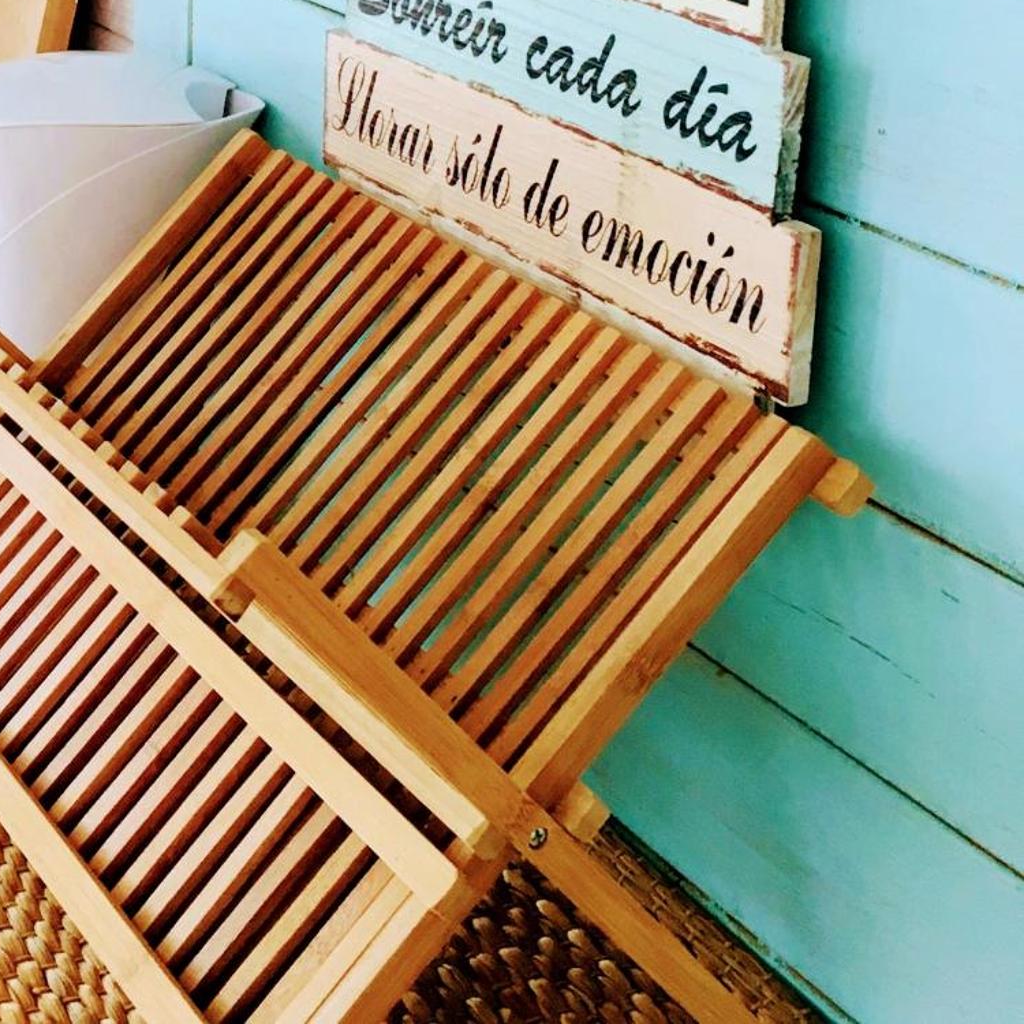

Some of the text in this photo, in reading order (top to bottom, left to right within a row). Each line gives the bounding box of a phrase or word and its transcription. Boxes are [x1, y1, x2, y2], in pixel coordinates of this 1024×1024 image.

[331, 57, 768, 335] Llorar sólo de emoción
[525, 33, 643, 118] cada
[662, 65, 758, 163] día
